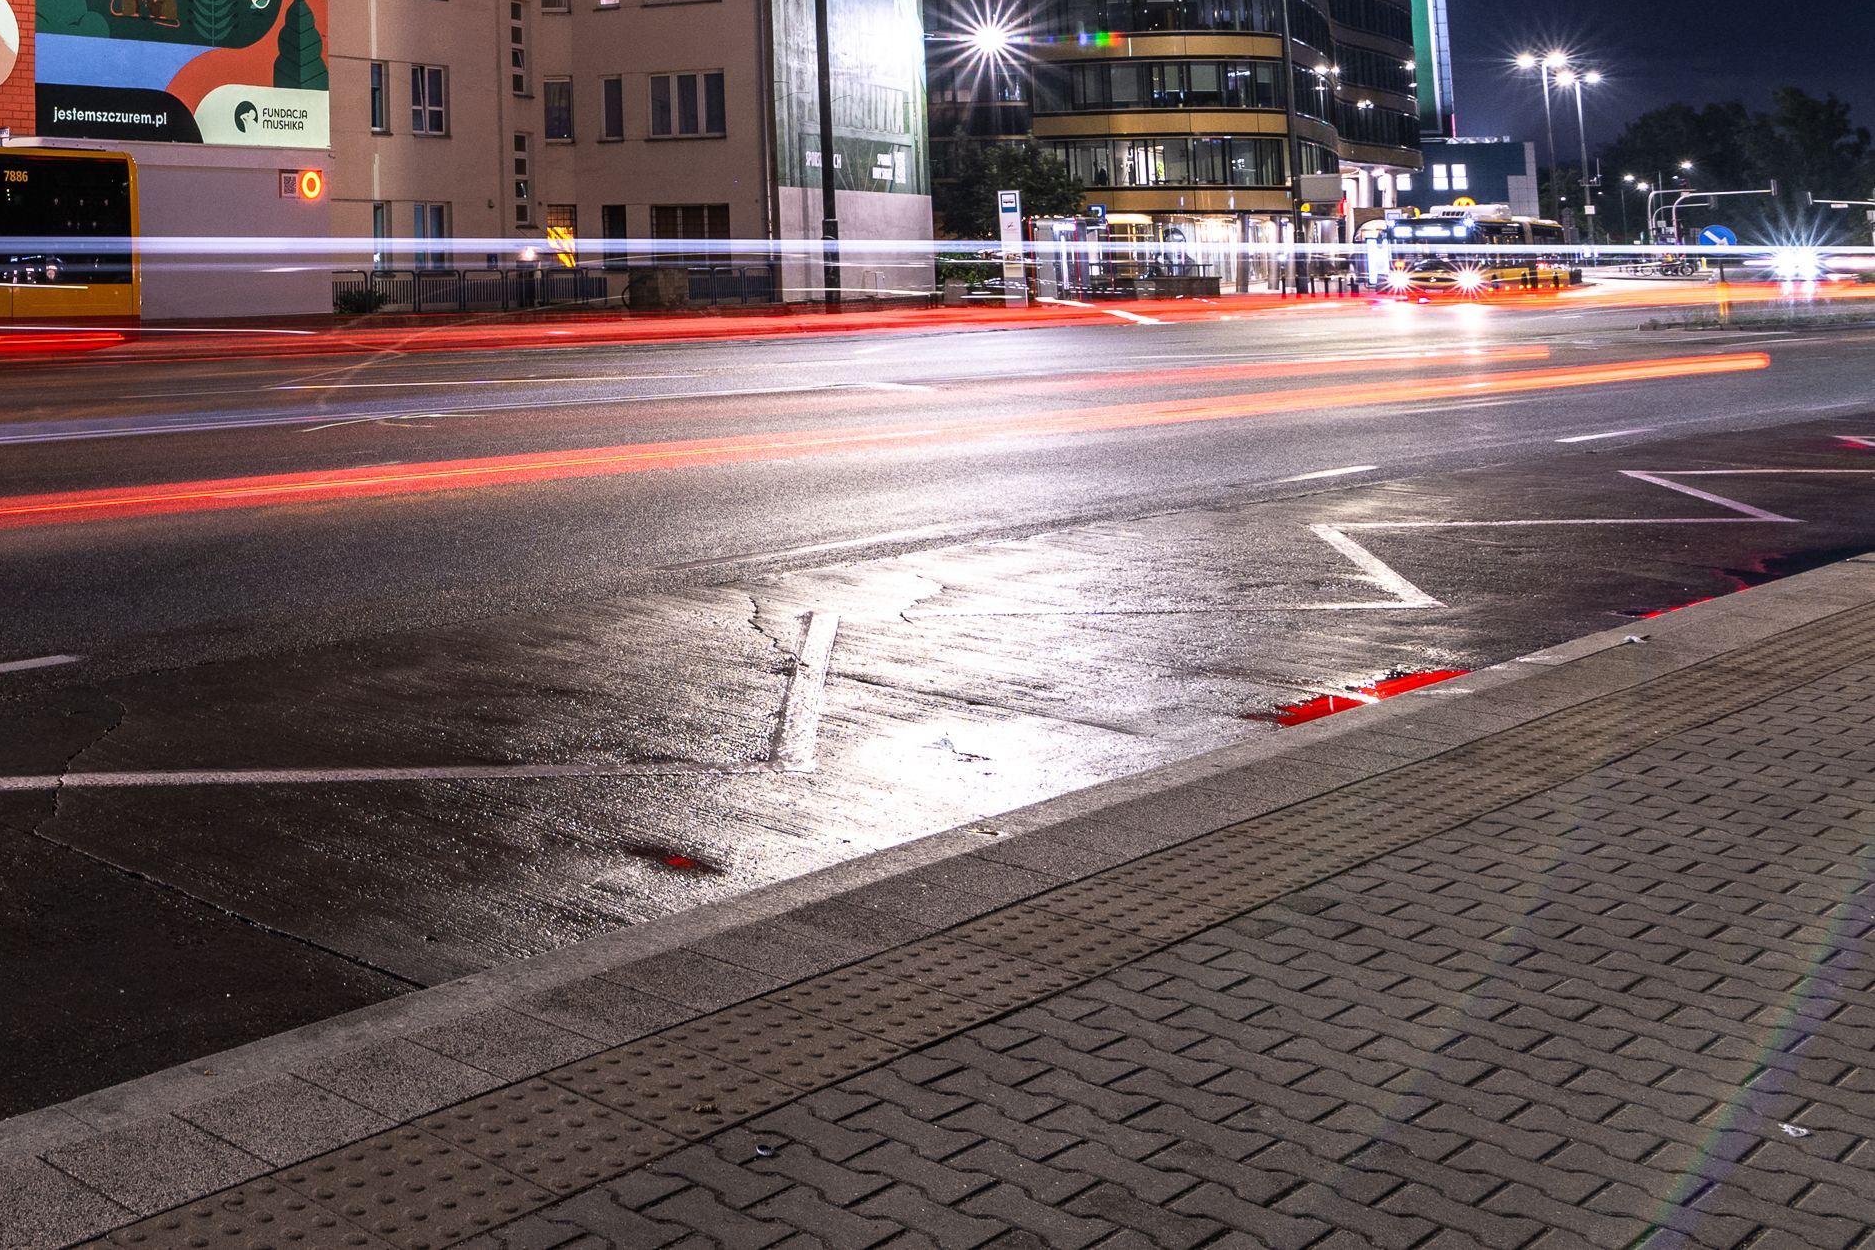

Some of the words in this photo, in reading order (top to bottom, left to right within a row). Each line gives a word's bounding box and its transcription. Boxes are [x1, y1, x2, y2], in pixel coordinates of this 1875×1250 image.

[53, 105, 167, 127] jestemszczurem.pl
[262, 107, 308, 120] FUNDACJA
[262, 119, 304, 131] MUSHIKA
[3, 170, 29, 183] 7886
